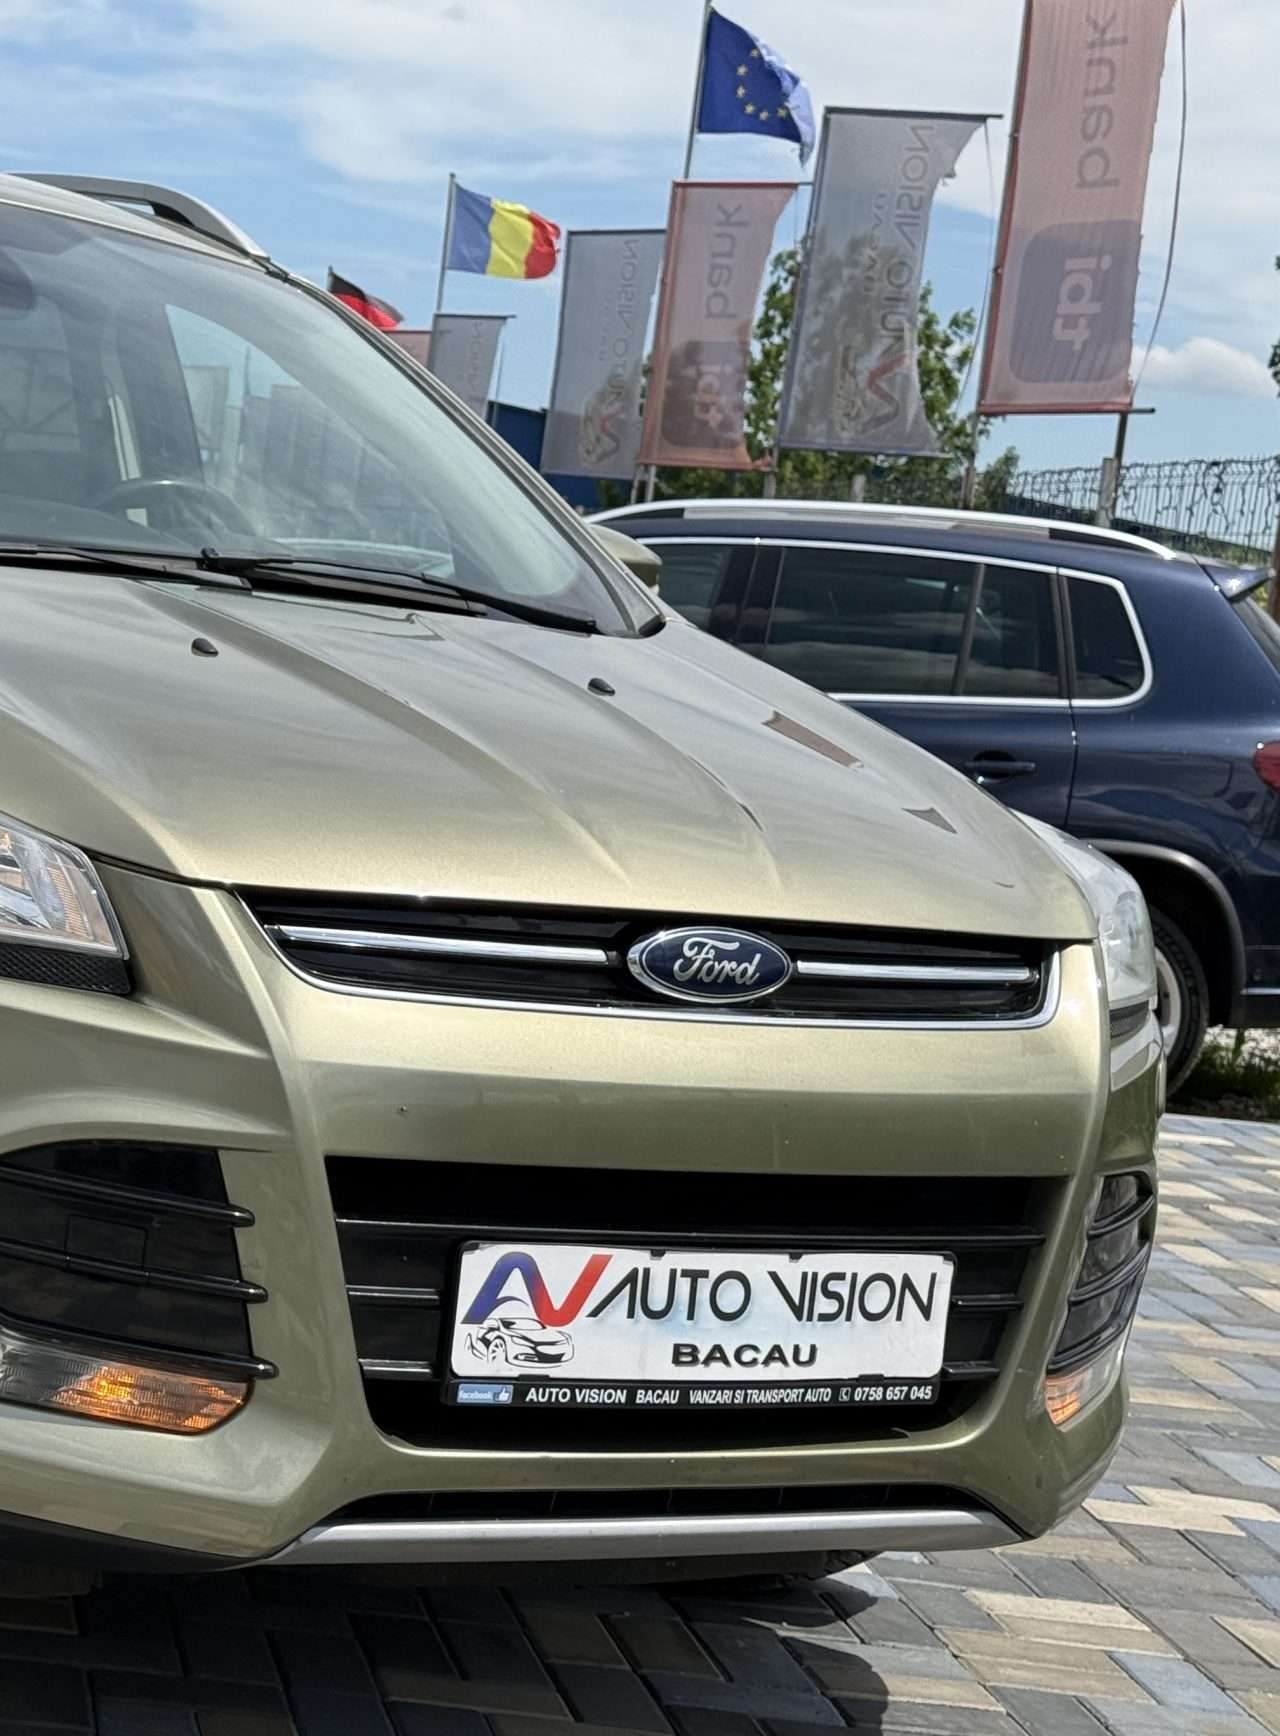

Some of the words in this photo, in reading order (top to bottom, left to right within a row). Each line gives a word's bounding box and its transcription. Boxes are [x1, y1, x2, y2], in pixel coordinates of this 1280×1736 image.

[673, 937, 761, 985] Ford
[586, 1267, 752, 1323] AUTO
[767, 1270, 938, 1323] VISION
[671, 1342, 818, 1369] BACAU
[525, 1387, 570, 1403] AUTO
[575, 1388, 627, 1404] VISION
[635, 1389, 680, 1404] BACAU
[689, 1389, 733, 1405] VANZARI
[734, 1389, 745, 1404] SI
[746, 1388, 804, 1404] TRANSPORT
[804, 1387, 832, 1402] AUTO
[854, 1386, 884, 1401] 0758
[886, 1386, 908, 1401] 657
[910, 1385, 933, 1400] 045
